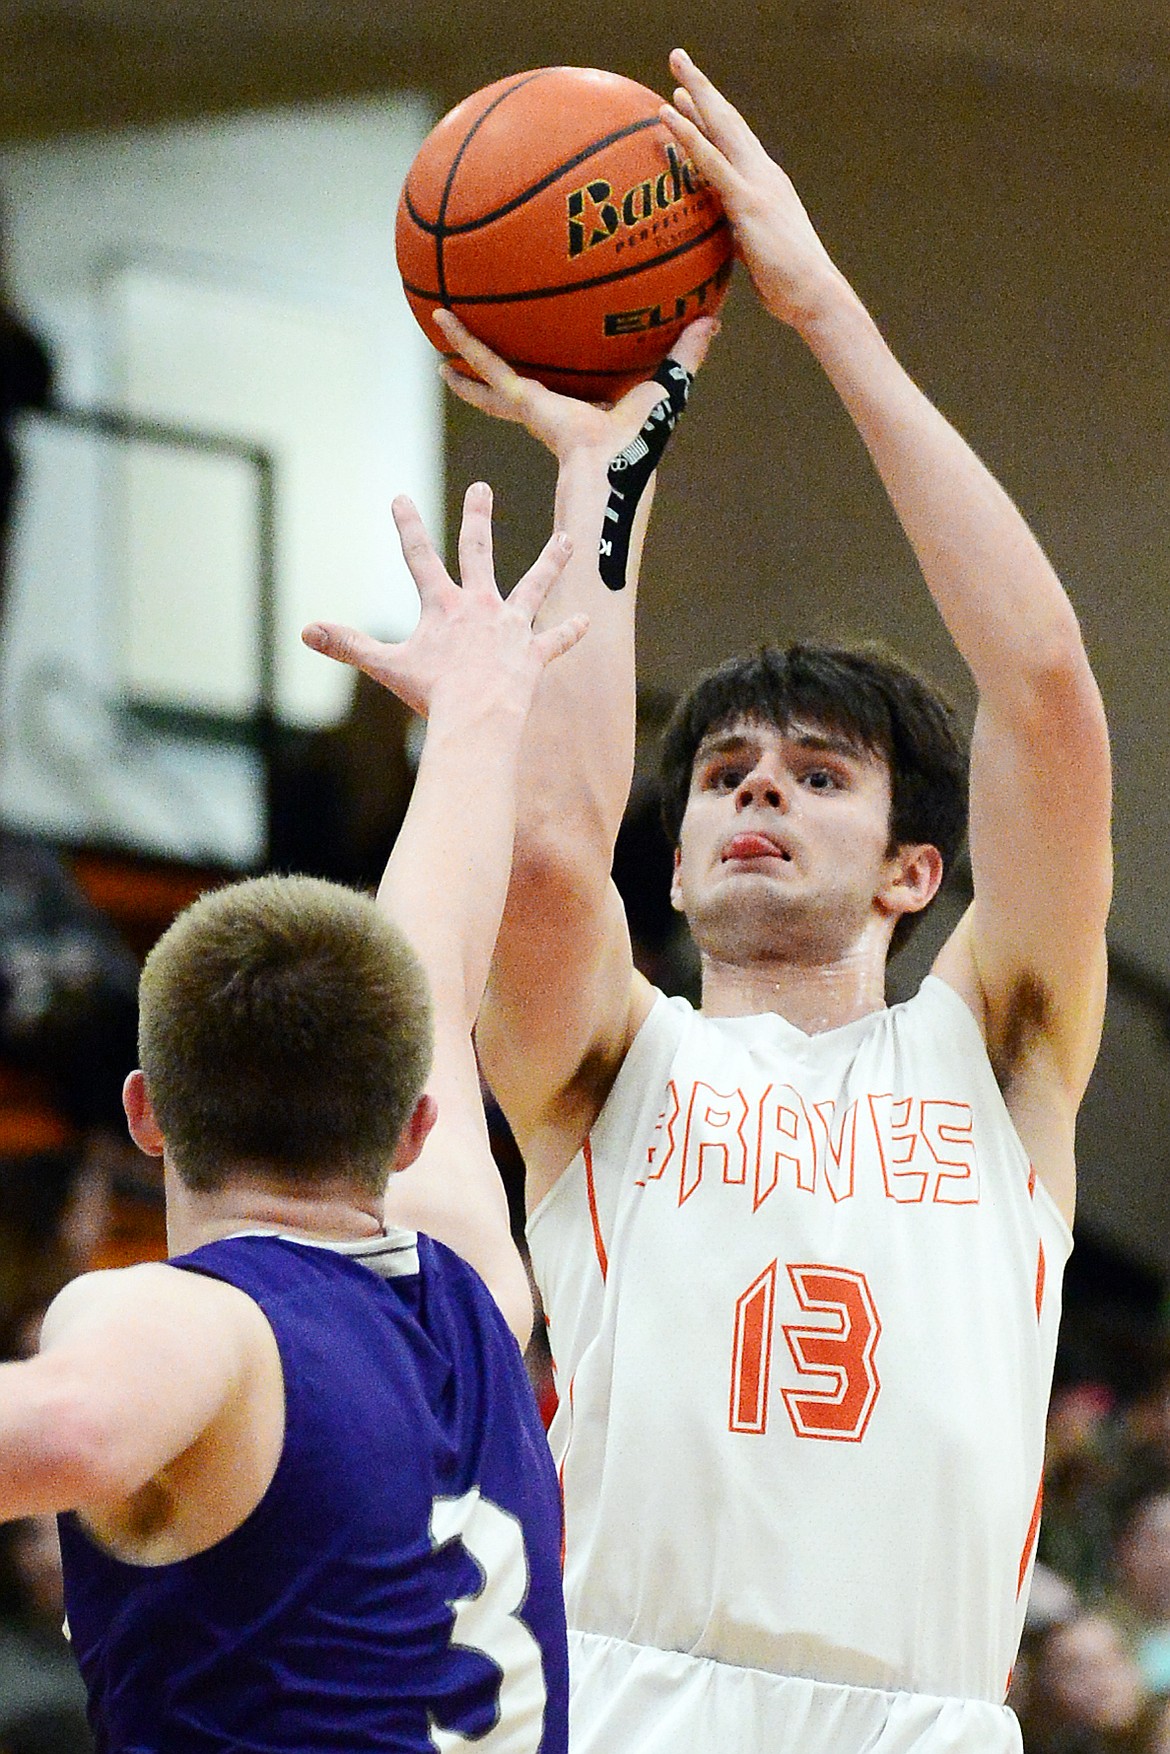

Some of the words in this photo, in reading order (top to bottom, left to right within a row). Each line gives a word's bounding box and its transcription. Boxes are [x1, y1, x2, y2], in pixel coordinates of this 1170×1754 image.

[634, 1079, 981, 1213] BRAVES
[728, 1257, 882, 1443] 13
[428, 1485, 547, 1754] 3
